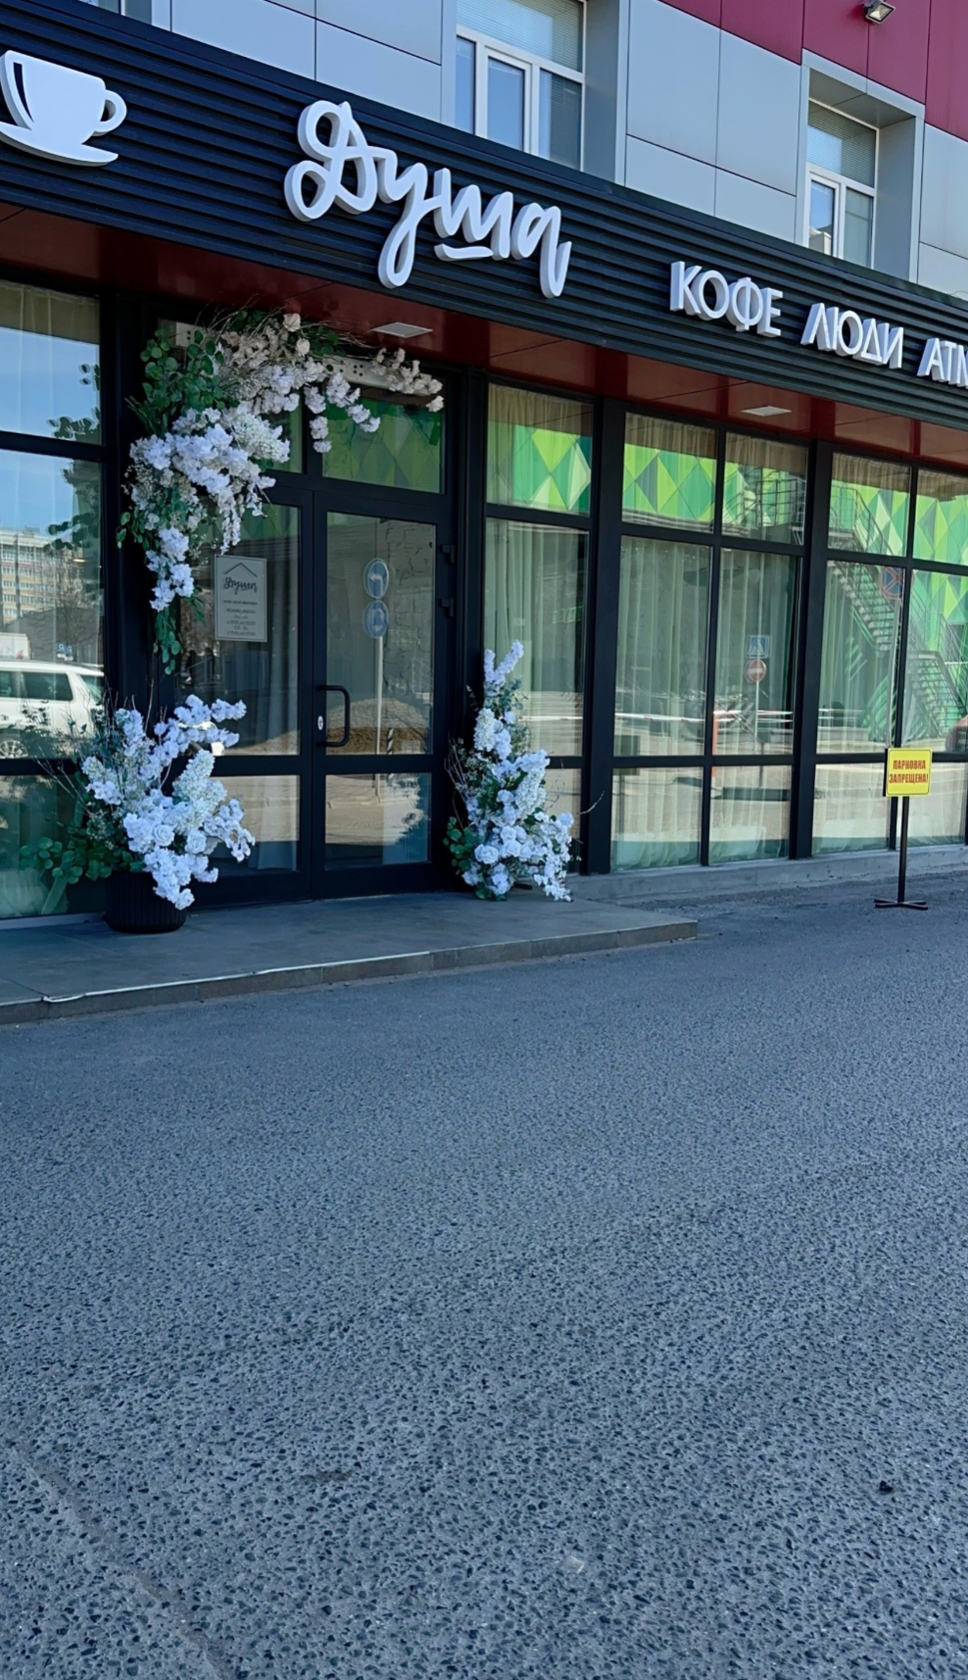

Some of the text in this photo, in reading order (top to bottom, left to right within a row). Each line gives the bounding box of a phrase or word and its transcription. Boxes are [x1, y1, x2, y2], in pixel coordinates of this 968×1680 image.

[284, 100, 572, 298] Душа
[669, 260, 784, 338] КОФЕ
[800, 302, 904, 369] ЛЮДИ
[889, 773, 928, 784] ЗАПРЕЩЕНА!
[893, 760, 926, 770] ПАРКОВКА
